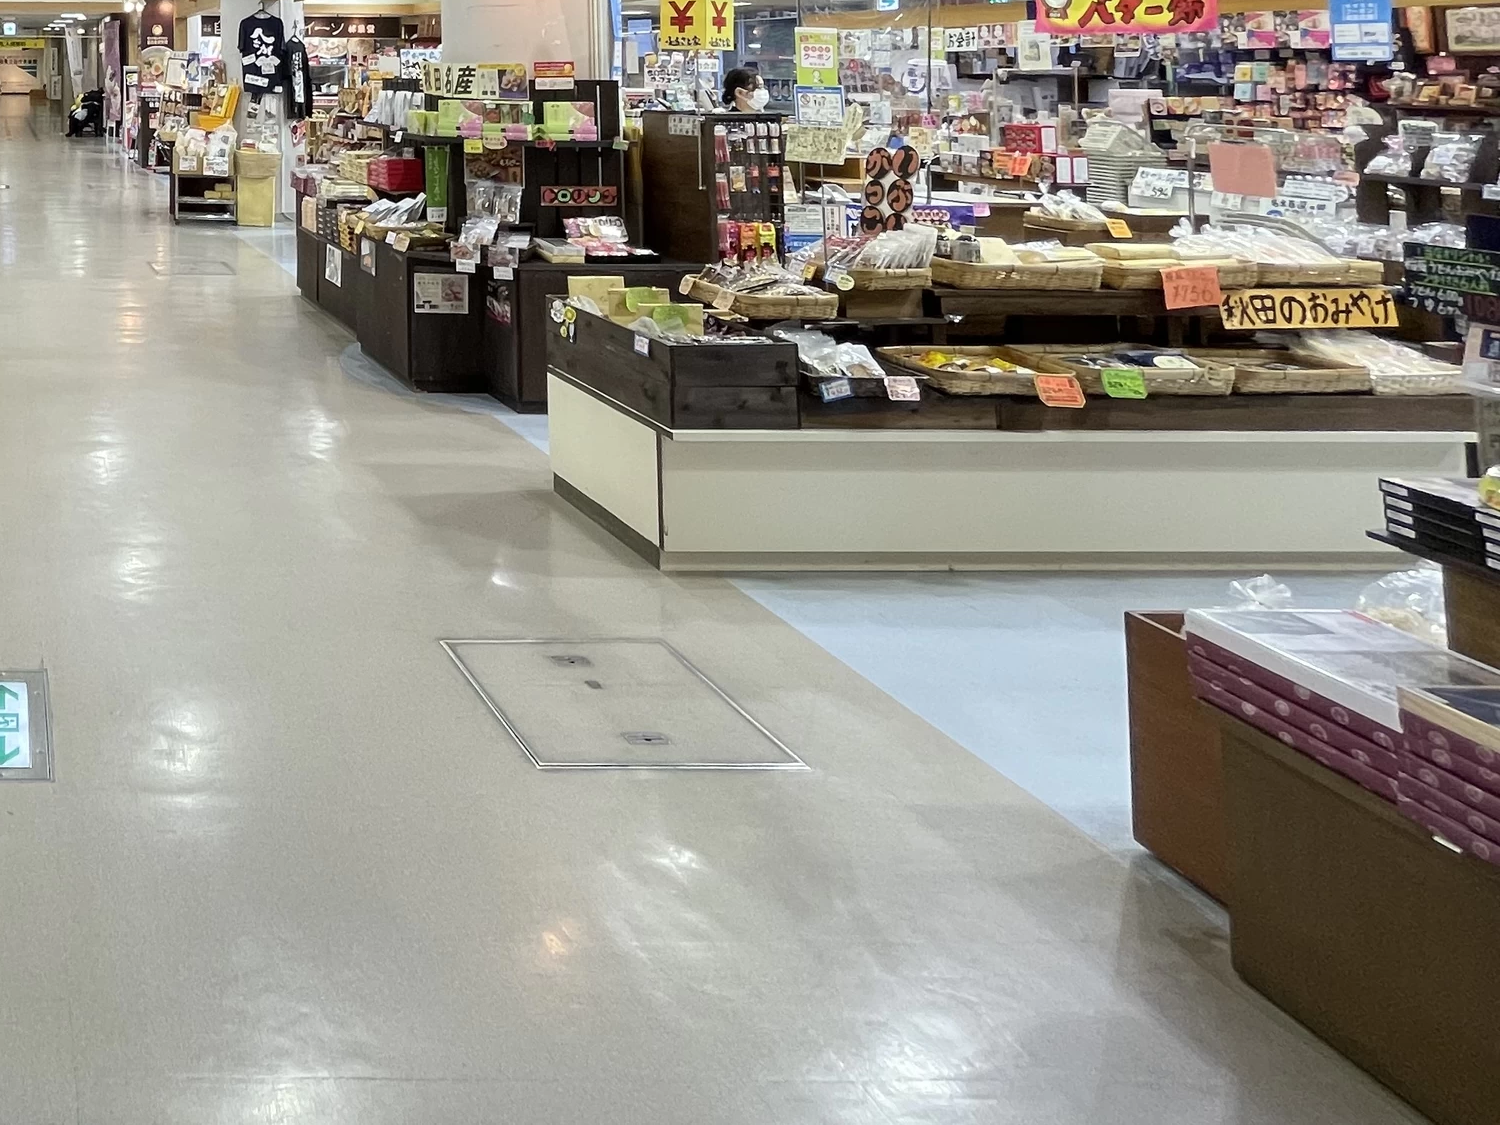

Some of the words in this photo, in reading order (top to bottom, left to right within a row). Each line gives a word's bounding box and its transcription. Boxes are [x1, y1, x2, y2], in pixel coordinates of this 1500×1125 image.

[947, 30, 976, 50] お会計
[803, 53, 831, 62] クーポン
